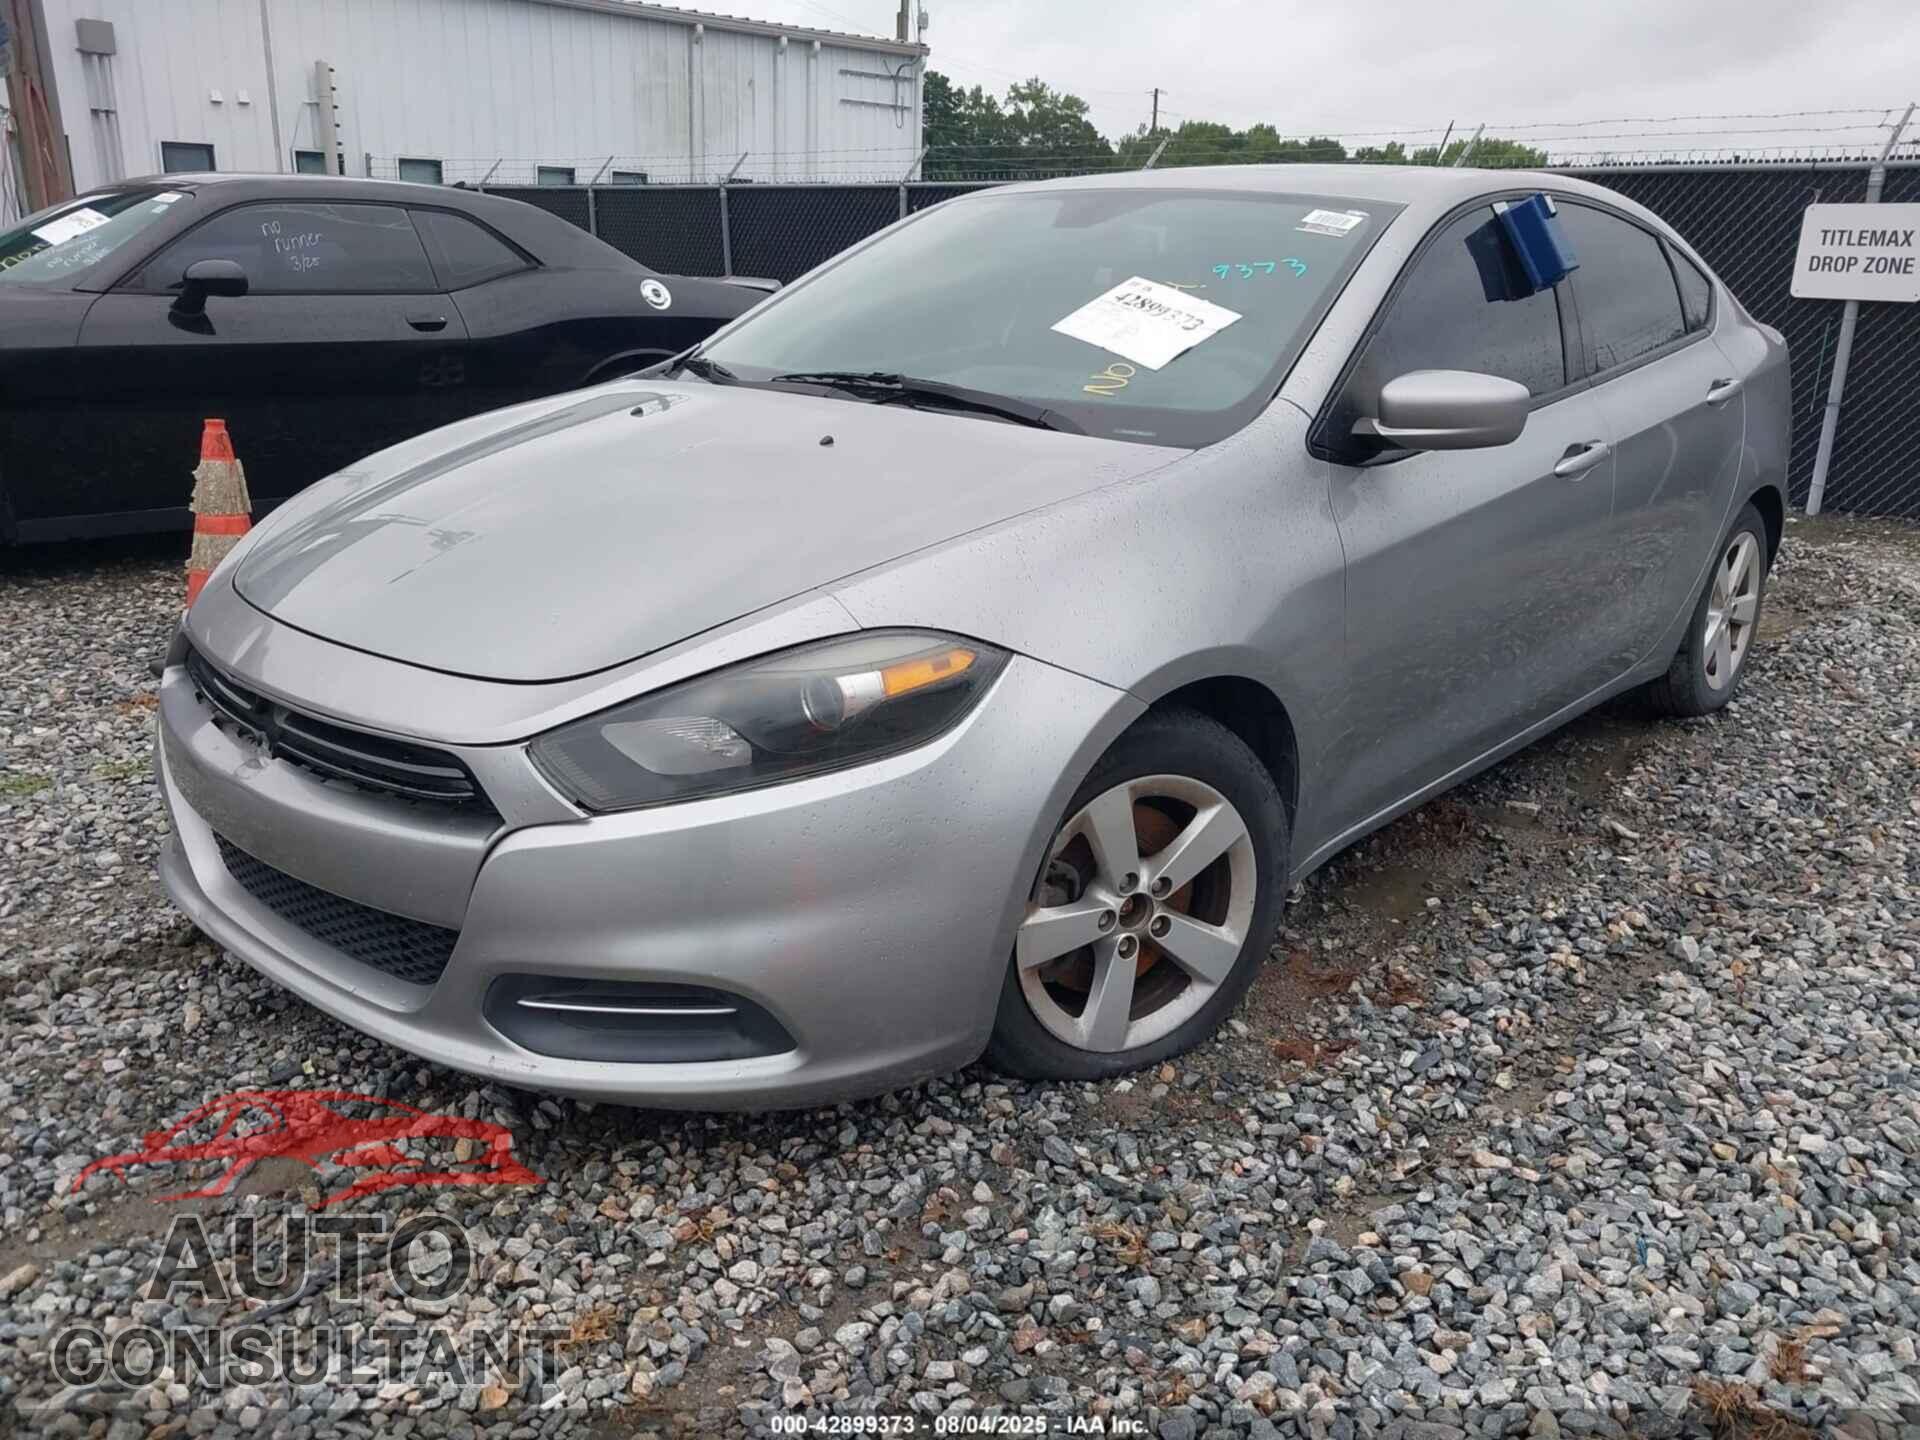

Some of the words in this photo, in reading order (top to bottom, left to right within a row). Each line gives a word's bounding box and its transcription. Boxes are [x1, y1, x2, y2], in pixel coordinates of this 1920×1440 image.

[1820, 229, 1915, 247] TITLEMAX
[1212, 257, 1308, 280] 9373
[1808, 255, 1859, 272] DROP
[1862, 256, 1916, 274] ZONE
